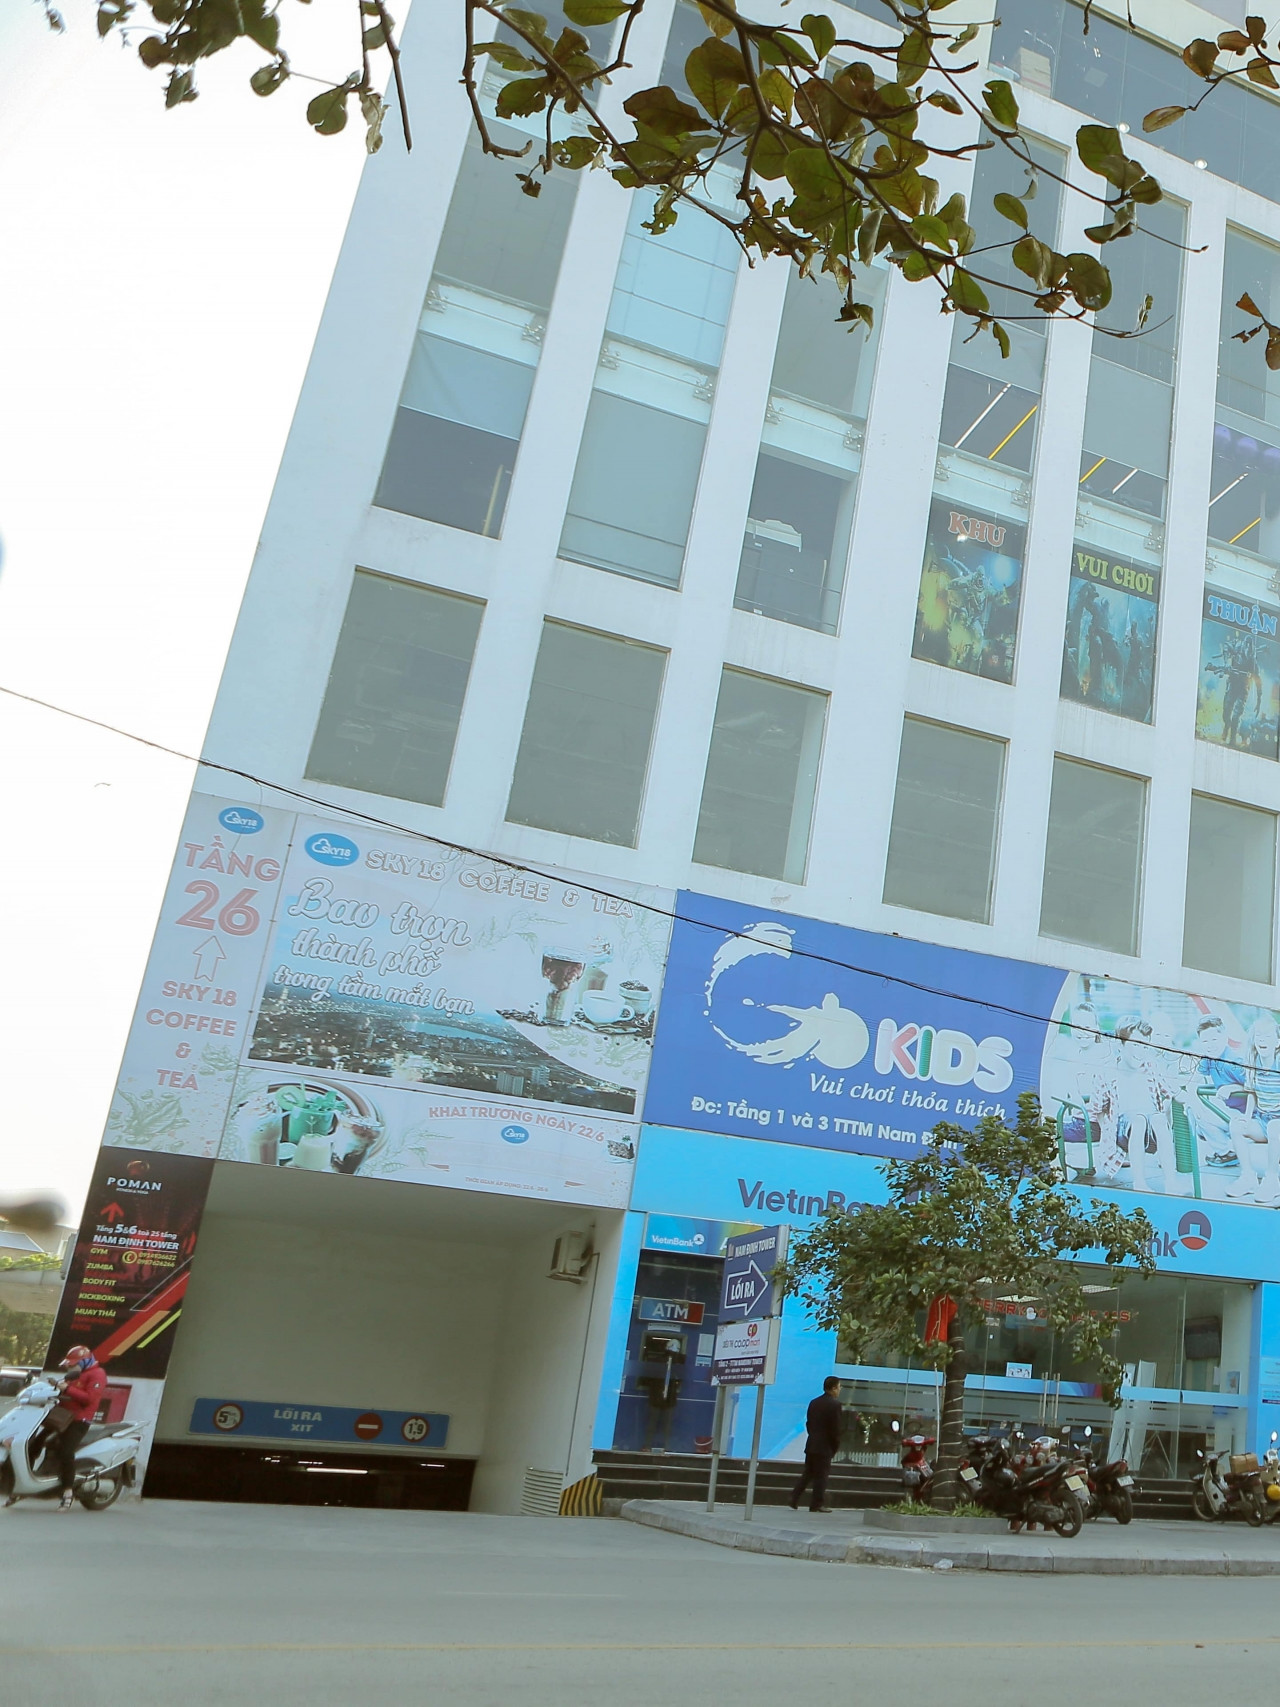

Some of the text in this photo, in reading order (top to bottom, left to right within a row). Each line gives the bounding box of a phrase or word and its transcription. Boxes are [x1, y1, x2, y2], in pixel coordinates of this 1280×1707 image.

[948, 511, 1007, 548] KHU
[1076, 552, 1155, 596] VUI CHƠI
[1207, 594, 1278, 638] THUẬN
[184, 835, 281, 882] TẦNG
[364, 849, 634, 919] SKY 18 COFFEE & TEA
[175, 879, 260, 936] 26
[391, 901, 472, 951] trọn
[291, 927, 444, 979] thành phố
[162, 980, 238, 1007] SKY 18
[273, 964, 476, 1018] trong tầm mắt bạn
[146, 1009, 237, 1037] COFFEE
[175, 1042, 192, 1059] &
[874, 1018, 1014, 1094] KIDS
[156, 1068, 199, 1091] TEA
[809, 1073, 1007, 1120] Vui chơi thỏa thích
[429, 1106, 467, 1118] KHAI
[535, 1113, 578, 1132] NGÀY
[577, 1125, 605, 1142] 22/6
[691, 1096, 722, 1115] Đc:
[727, 1098, 771, 1126] Tầng
[777, 1109, 784, 1124] 1
[791, 1109, 813, 1129] và
[818, 1117, 829, 1131] 3
[833, 1117, 874, 1138] TTTM
[878, 1125, 917, 1145] Nam
[106, 1176, 162, 1191] POMAN
[738, 1178, 899, 1220] VietinBa
[90, 1247, 109, 1255] GYM
[93, 1234, 179, 1250] NAM ĐỊNH TOWER
[652, 1234, 694, 1247] VietinBank
[86, 1262, 114, 1271] ZUMBA
[82, 1277, 104, 1286] BODY
[731, 1277, 755, 1300] LỐI RA
[78, 1292, 125, 1303] KICKBOXING
[652, 1303, 688, 1319] ATM
[75, 1308, 99, 1316] MUAY
[300, 1411, 323, 1421] RA
